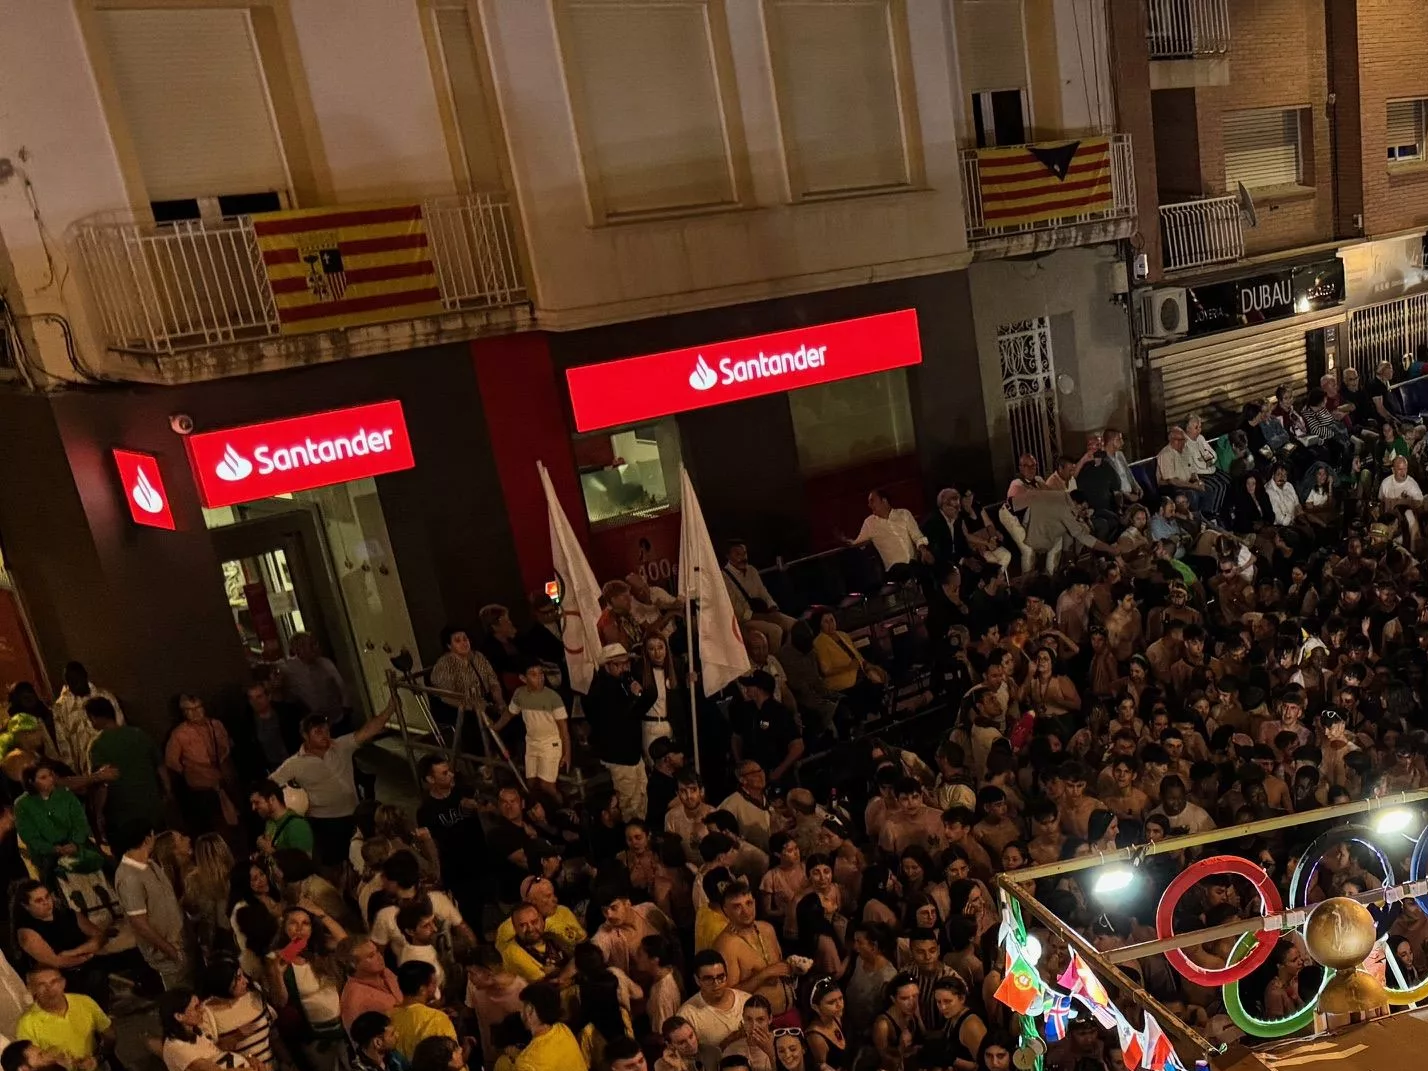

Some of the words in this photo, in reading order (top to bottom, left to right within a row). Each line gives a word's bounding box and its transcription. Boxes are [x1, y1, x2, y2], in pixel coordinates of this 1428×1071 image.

[1241, 279, 1293, 313] DUBAU
[718, 343, 827, 386] Santander
[254, 427, 393, 475] Santander
